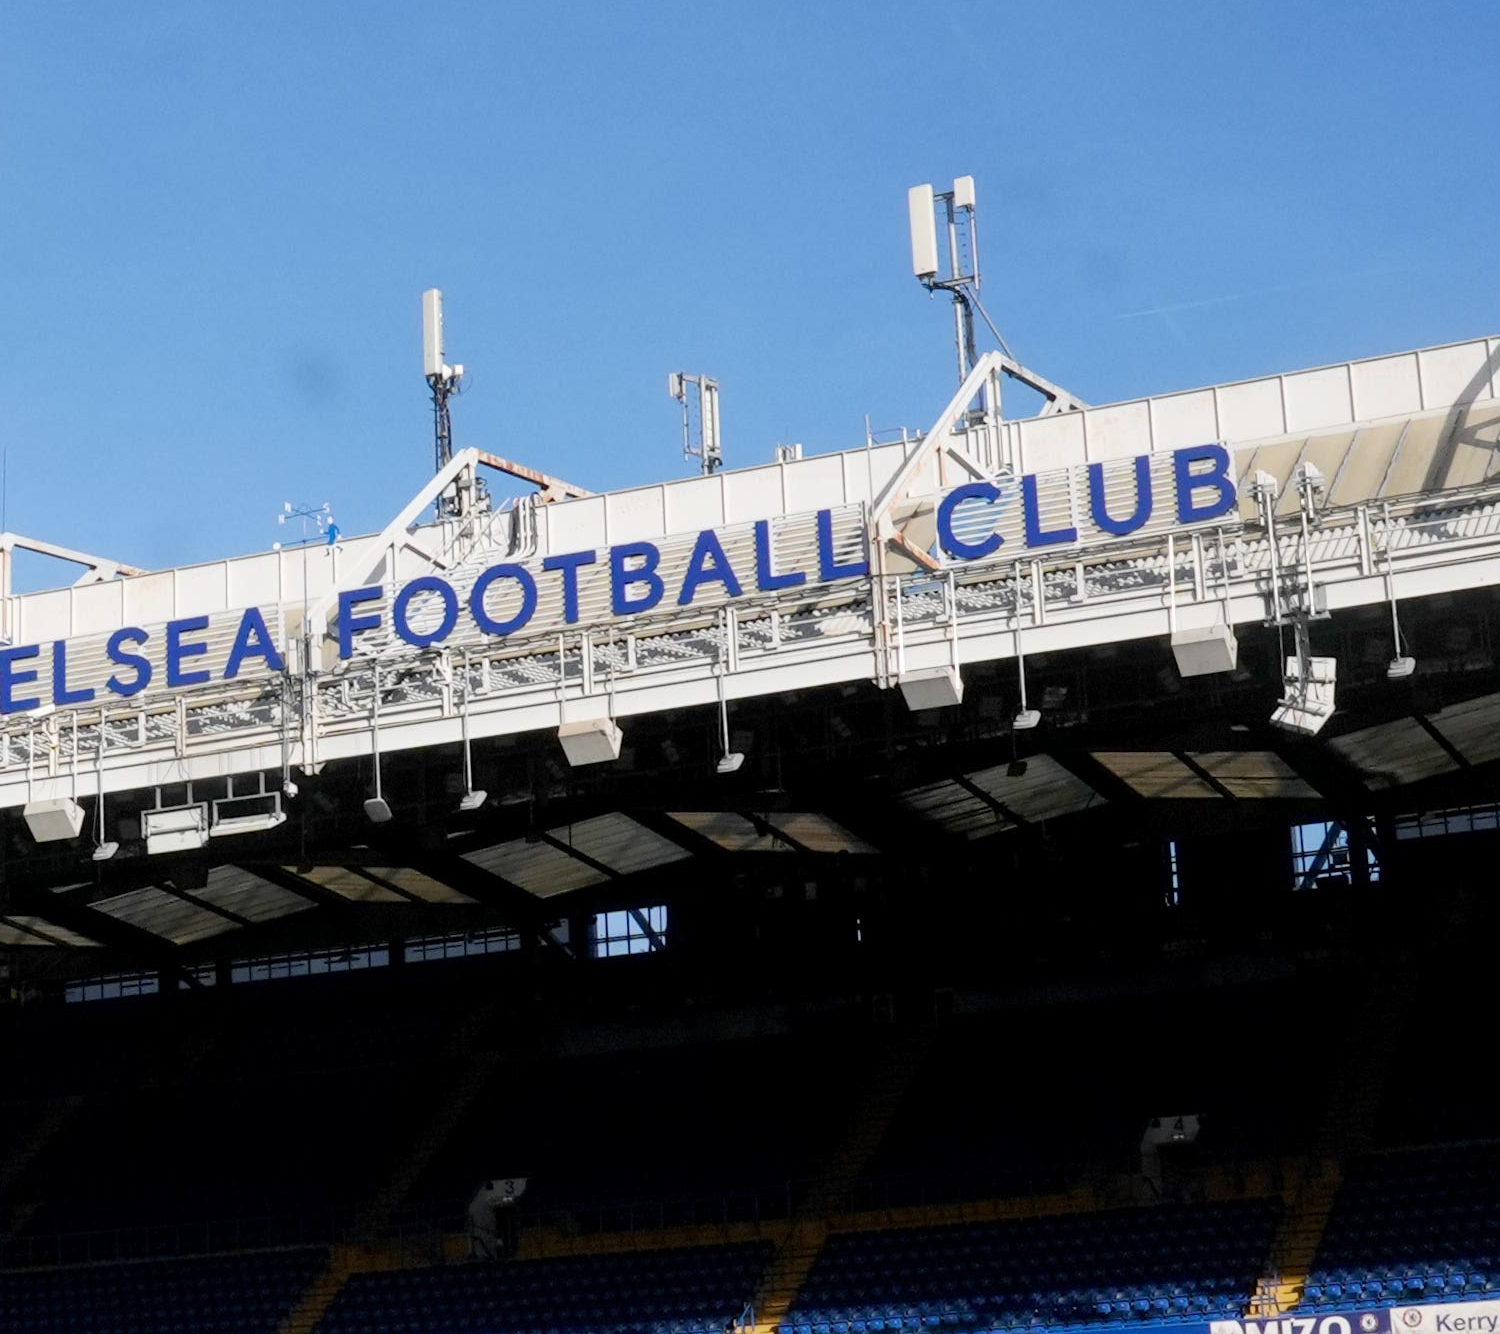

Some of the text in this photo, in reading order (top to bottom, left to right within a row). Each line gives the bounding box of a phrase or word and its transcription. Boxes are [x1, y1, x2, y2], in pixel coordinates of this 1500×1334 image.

[338, 507, 873, 660] FOOTBALL
[936, 444, 1238, 564] CLUB
[1436, 1313, 1498, 1333] Kerry
